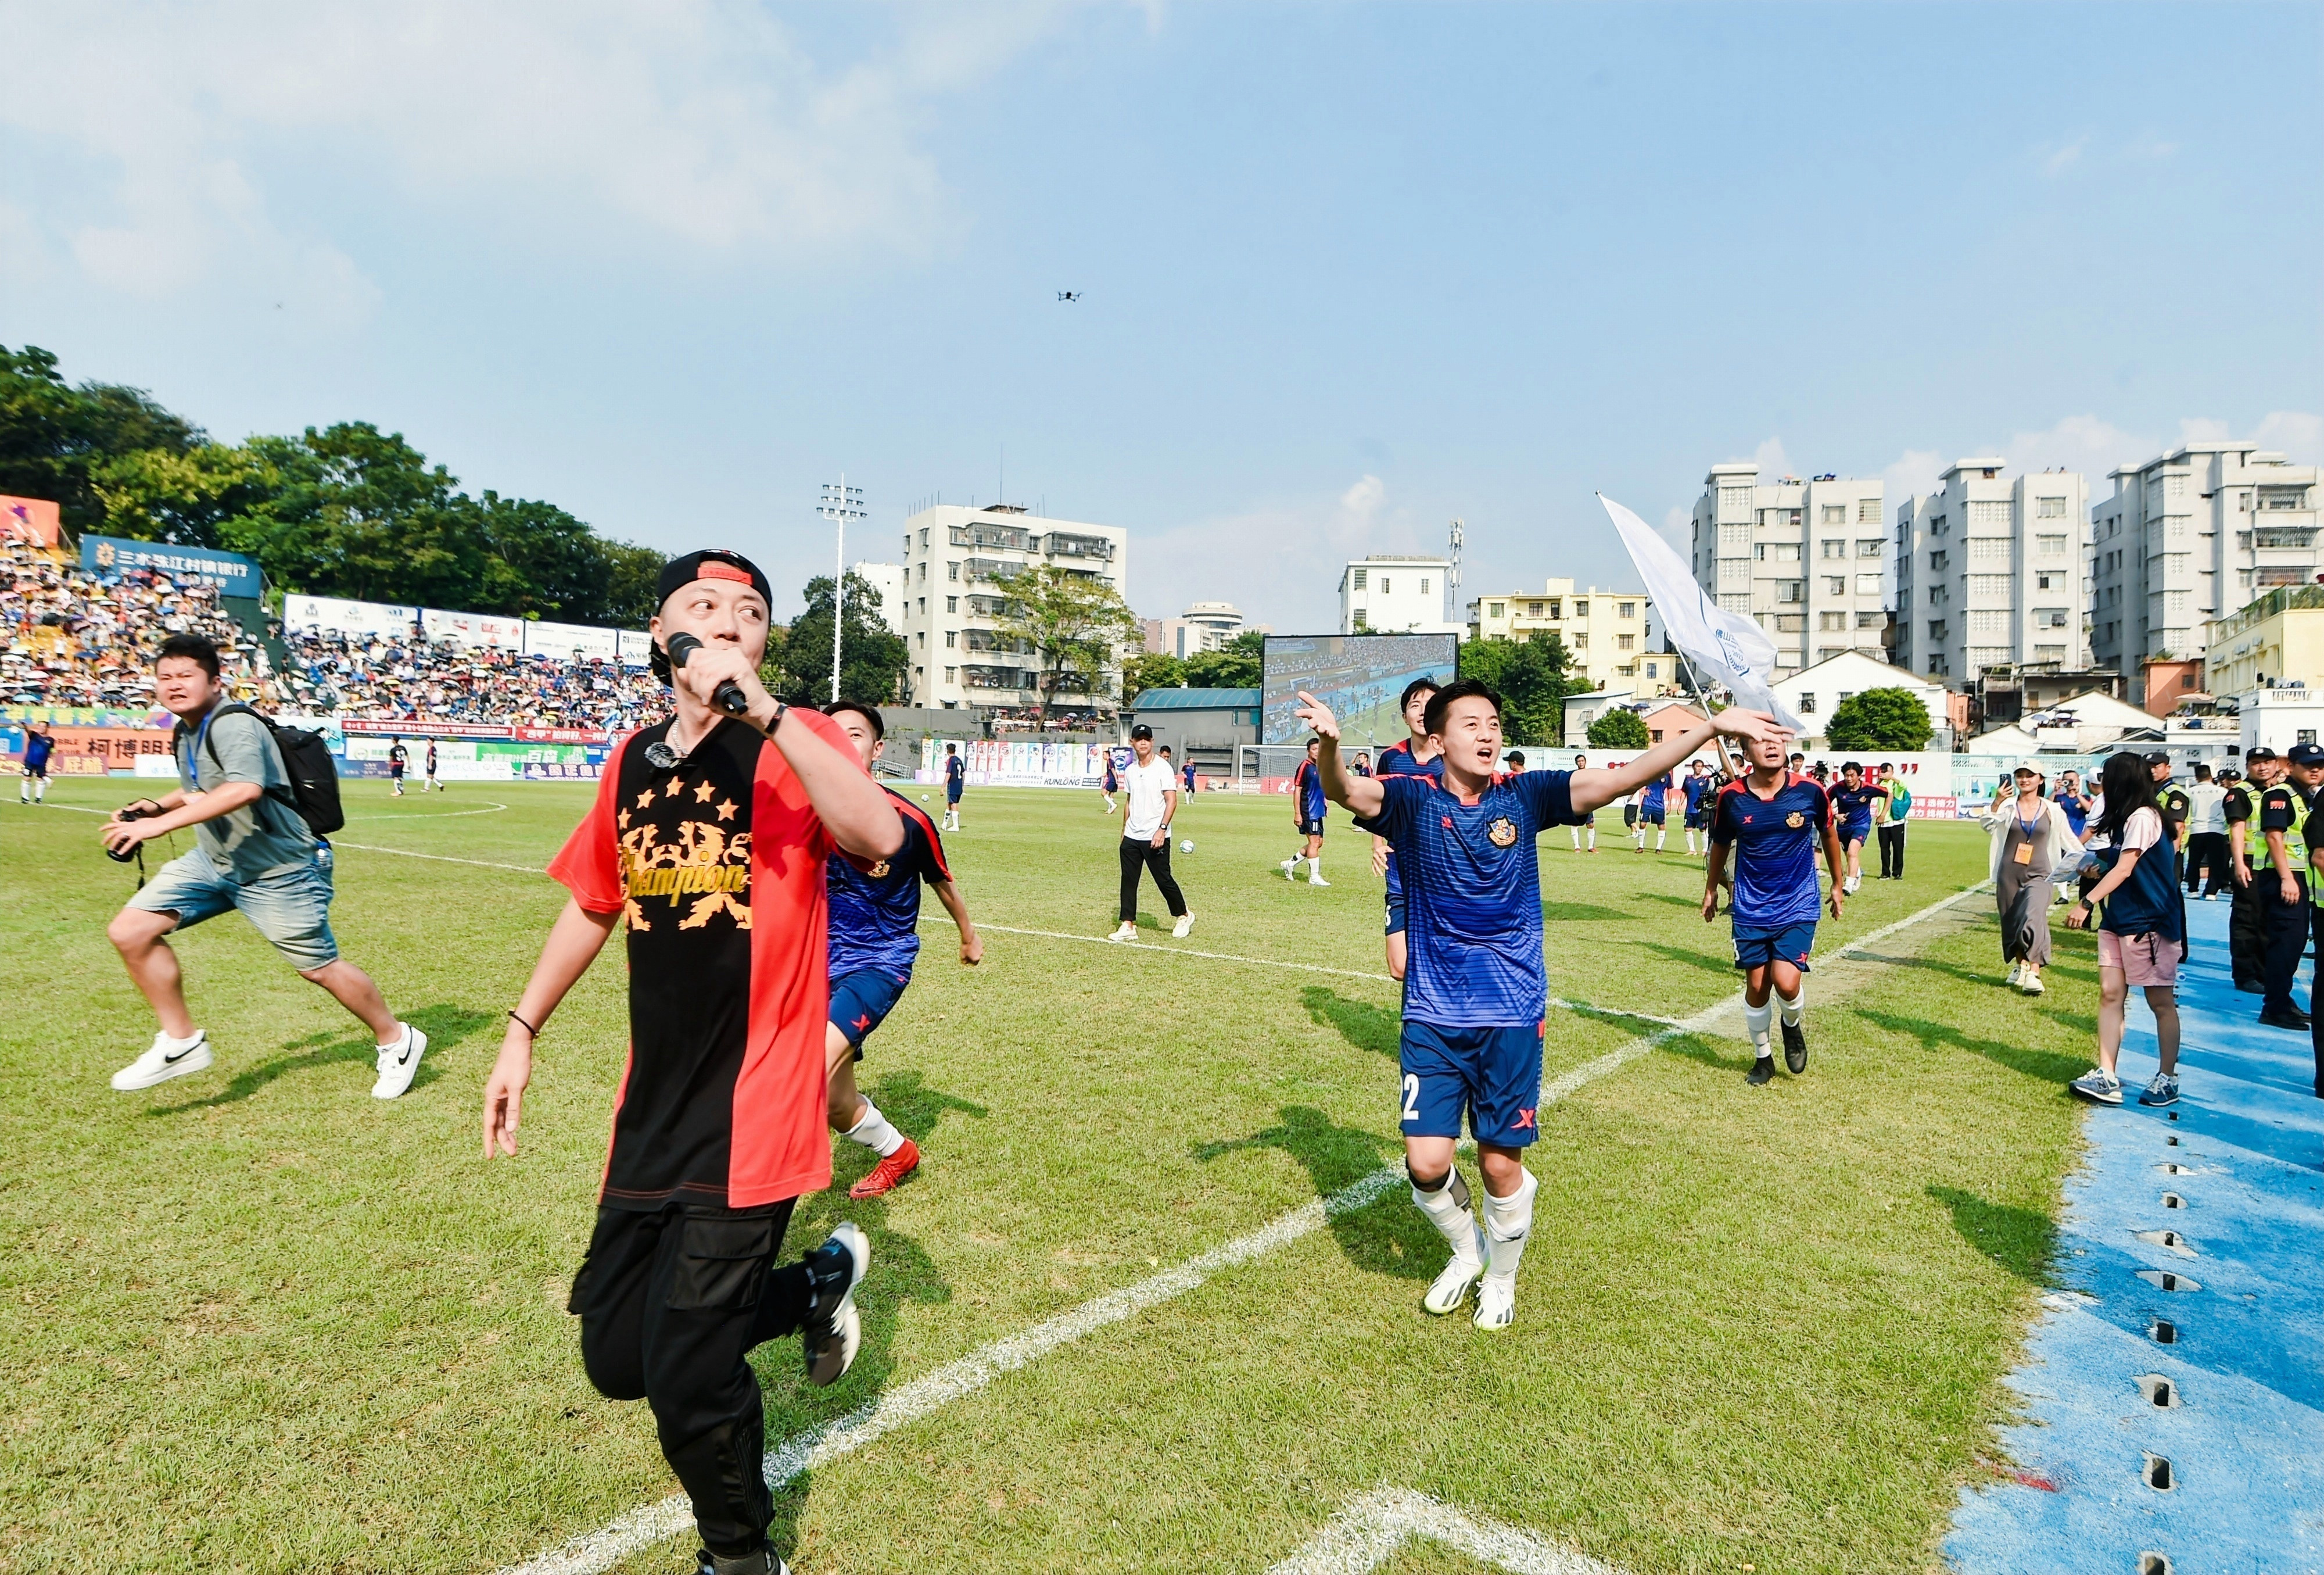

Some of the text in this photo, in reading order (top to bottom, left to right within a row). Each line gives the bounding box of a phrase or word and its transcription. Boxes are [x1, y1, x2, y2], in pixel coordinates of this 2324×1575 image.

[88, 738, 174, 758] 柯博明
[956, 764, 962, 779] 2
[1044, 778, 1080, 786] KUNLONG
[1312, 822, 1318, 832] 11
